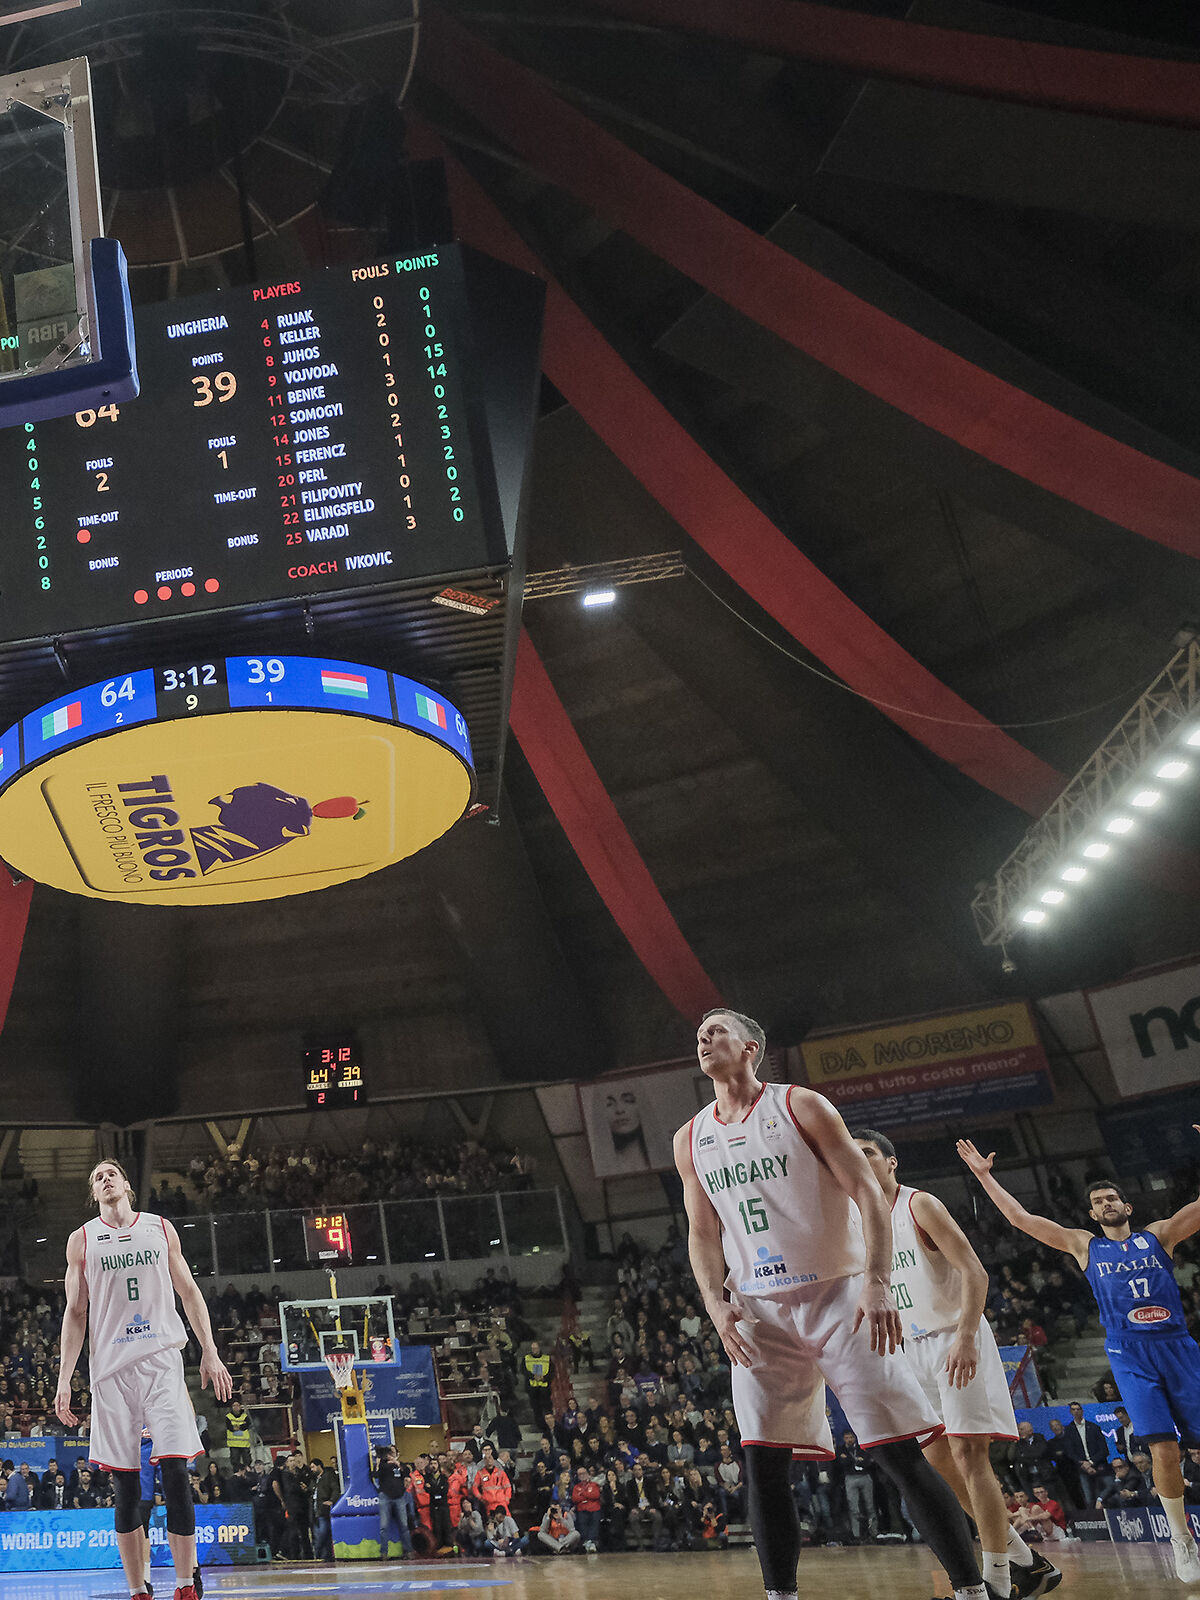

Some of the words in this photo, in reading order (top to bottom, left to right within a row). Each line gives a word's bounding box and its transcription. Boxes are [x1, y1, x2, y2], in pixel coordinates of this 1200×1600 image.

[252, 281, 302, 302] PLAYERS
[351, 263, 390, 282] FOULS
[395, 253, 439, 274] POINTS
[261, 319, 269, 329] 4
[277, 309, 314, 329] RUJAK
[373, 295, 384, 310] 0
[419, 286, 430, 301] 0
[166, 315, 229, 339] UNGHERIA
[264, 336, 272, 347] 6
[279, 326, 322, 346] KELLER
[375, 313, 387, 328] 2
[423, 305, 430, 317] 1
[265, 355, 274, 367] 8
[282, 345, 320, 365] JUHOS
[378, 332, 390, 347] 0
[424, 324, 436, 338] 0
[191, 352, 224, 367] POINTS
[268, 375, 277, 387] 9
[284, 362, 339, 384] VOJVODA
[383, 353, 390, 366] 1
[423, 342, 444, 359] 15
[191, 371, 237, 407] 39
[267, 394, 283, 407] 11
[287, 386, 326, 404] BENKE
[384, 372, 396, 387] 3
[426, 362, 448, 379] 14
[270, 414, 287, 427] 12
[289, 402, 344, 424] SOMOGYI
[387, 392, 399, 407] 0
[434, 384, 445, 399] 0
[24, 422, 35, 433] 6
[272, 434, 289, 447] 14
[293, 425, 331, 444] JONES
[390, 413, 402, 428] 2
[436, 404, 449, 420] 2
[26, 438, 37, 452] 4
[208, 435, 237, 450] FOULS
[275, 454, 292, 467] 15
[295, 443, 347, 464] FERENCZ
[395, 434, 402, 446] 1
[440, 424, 451, 440] 3
[28, 457, 39, 471] 0
[85, 457, 114, 471] FOULS
[217, 450, 229, 469] 1
[277, 474, 295, 487] 20
[298, 467, 328, 484] PERL
[398, 454, 405, 467] 1
[443, 445, 455, 461] 2
[30, 477, 41, 491] 4
[95, 473, 110, 492] 2
[280, 494, 296, 507] 21
[301, 482, 363, 505] FILIPOVITY
[399, 474, 411, 489] 0
[446, 465, 458, 481] 0
[33, 496, 43, 511] 5
[214, 487, 257, 504] TIME-OUT
[282, 512, 300, 525] 22
[303, 498, 375, 522] EILINGSFELD
[404, 495, 411, 508] 1
[449, 486, 461, 502] 2
[34, 516, 45, 530] 6
[77, 510, 120, 528] TIME-OUT
[285, 532, 303, 546] 25
[306, 523, 350, 543] VARADI
[405, 515, 417, 530] 3
[452, 507, 464, 522] 0
[36, 535, 47, 550] 2
[227, 533, 260, 549] BONUS
[38, 555, 49, 570] 0
[89, 556, 120, 571] BONUS
[155, 566, 194, 582] PERIODS
[287, 560, 338, 579] COACH
[345, 551, 394, 571] IVKOVIC
[40, 576, 51, 590] 8
[100, 676, 136, 708] 64
[162, 664, 218, 691] 3:12
[246, 658, 286, 684] 39
[115, 712, 124, 724] 2
[185, 694, 199, 711] 9
[265, 691, 273, 703] 1
[85, 782, 108, 792] IL
[89, 793, 124, 834] FRESCO
[117, 774, 198, 881] TIGROS
[106, 835, 136, 850] PIÙ
[112, 851, 144, 884] BUONO
[819, 1047, 867, 1076] DA
[873, 1019, 1015, 1067] MORENO
[310, 1068, 329, 1083] 64
[343, 1066, 361, 1081] 39
[330, 1063, 337, 1071] 4
[878, 1073, 917, 1090] tutto
[921, 1063, 966, 1084] costa
[317, 1092, 326, 1104] 2
[353, 1089, 358, 1101] 1
[704, 1154, 789, 1195] HUNGARY
[315, 1215, 343, 1230] 3:12
[738, 1197, 770, 1235] 15
[328, 1227, 345, 1251] 9
[100, 1249, 161, 1272] HUNGARY
[753, 1263, 787, 1279] K&H
[1096, 1254, 1163, 1278] ITALIA
[126, 1277, 140, 1302] 6
[890, 1282, 914, 1311] 20
[1128, 1277, 1151, 1299] 17
[125, 1324, 151, 1335] K&H
[1, 1530, 54, 1551] WORLD
[55, 1530, 87, 1549] CUP
[217, 1524, 249, 1544] APP
